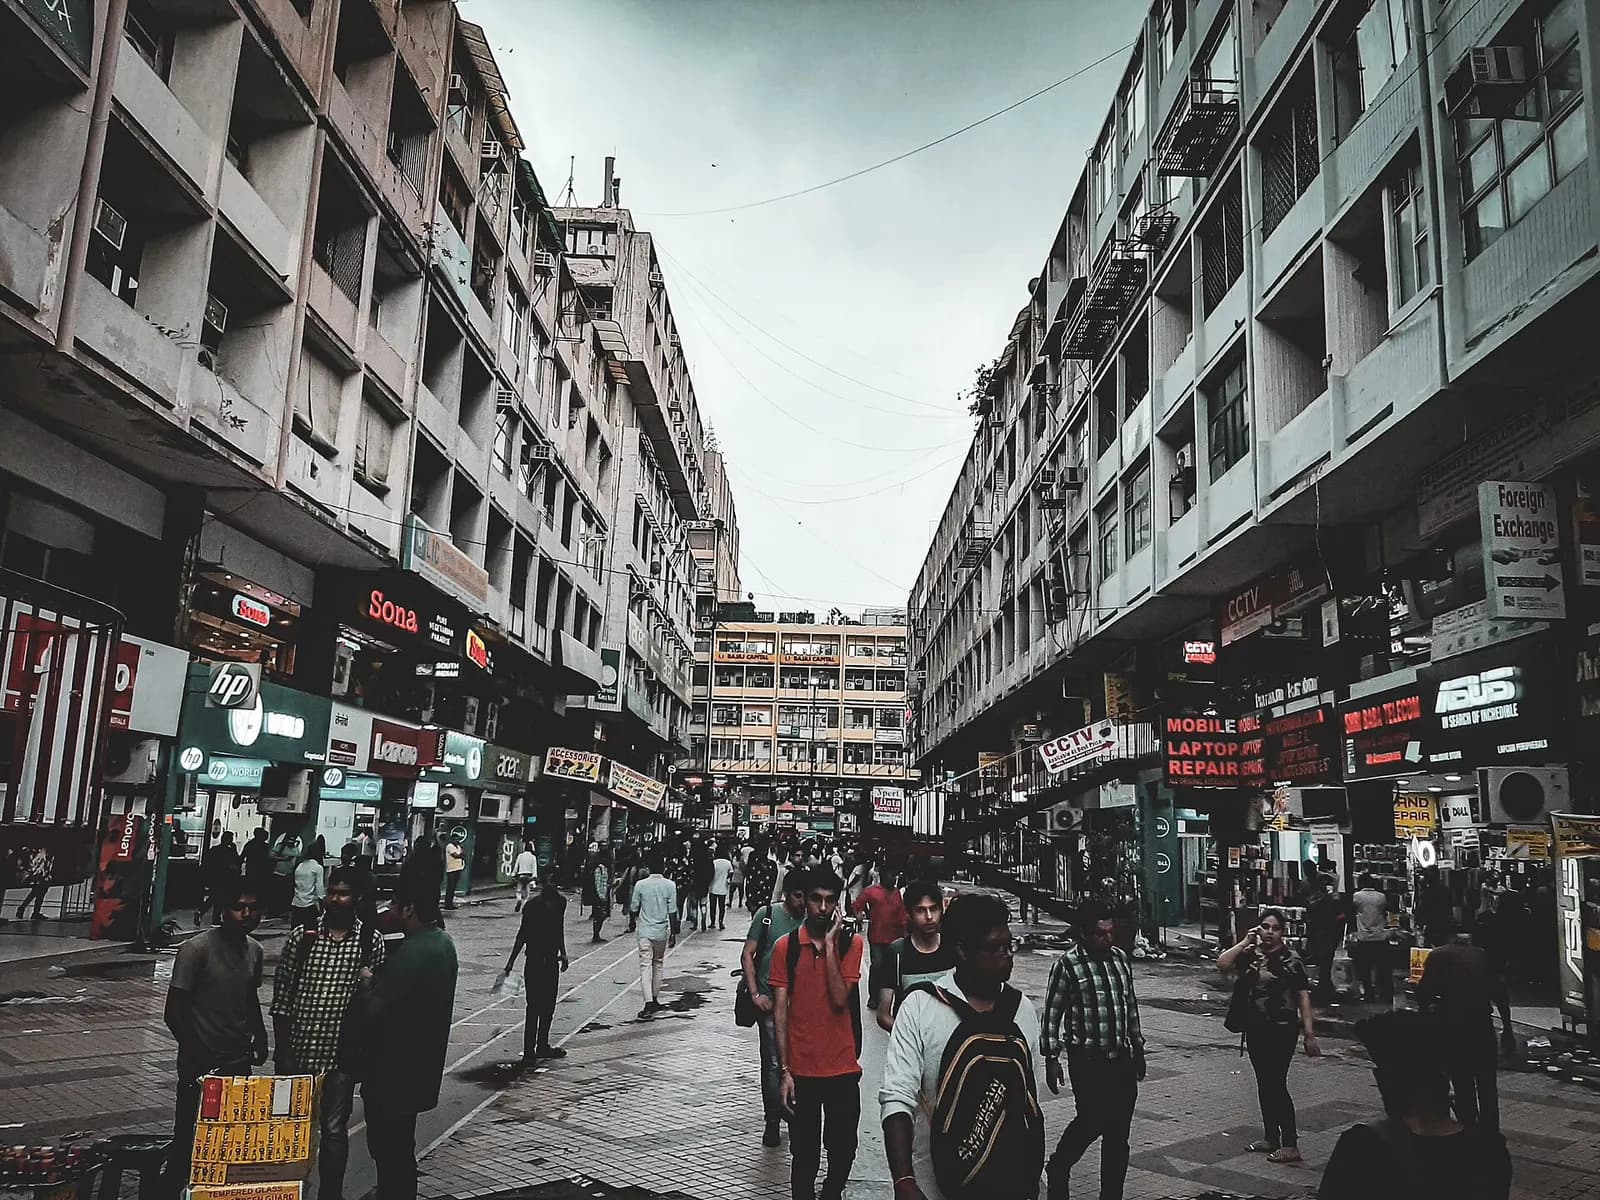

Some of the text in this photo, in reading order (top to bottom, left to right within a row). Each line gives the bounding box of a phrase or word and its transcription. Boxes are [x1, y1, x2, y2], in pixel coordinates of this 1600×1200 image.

[1498, 485, 1545, 514] Foreign
[1494, 514, 1555, 544] Exchange
[369, 589, 419, 633] Sona
[1228, 586, 1259, 621] CCTV
[1185, 641, 1215, 653] CCTV
[209, 663, 249, 705] hp
[1435, 666, 1517, 714] ASUS
[1382, 696, 1421, 724] TELECOM
[1167, 718, 1237, 733] MOBILE
[1043, 727, 1094, 757] CCTV
[1168, 741, 1238, 756] LAPTOP
[183, 748, 200, 770] hp
[497, 754, 520, 778] acer
[550, 749, 599, 764] ACCESSORIES
[1169, 760, 1238, 775] REPAIR
[210, 761, 259, 780] hp WORLD
[880, 797, 901, 807] Data
[1453, 806, 1469, 817] DELL
[1393, 811, 1430, 821] EPAIR
[117, 811, 134, 857] Lenovo
[501, 833, 514, 876] acer
[1561, 858, 1584, 982] ASUS
[208, 1186, 283, 1198] TEMPERED GLASS
